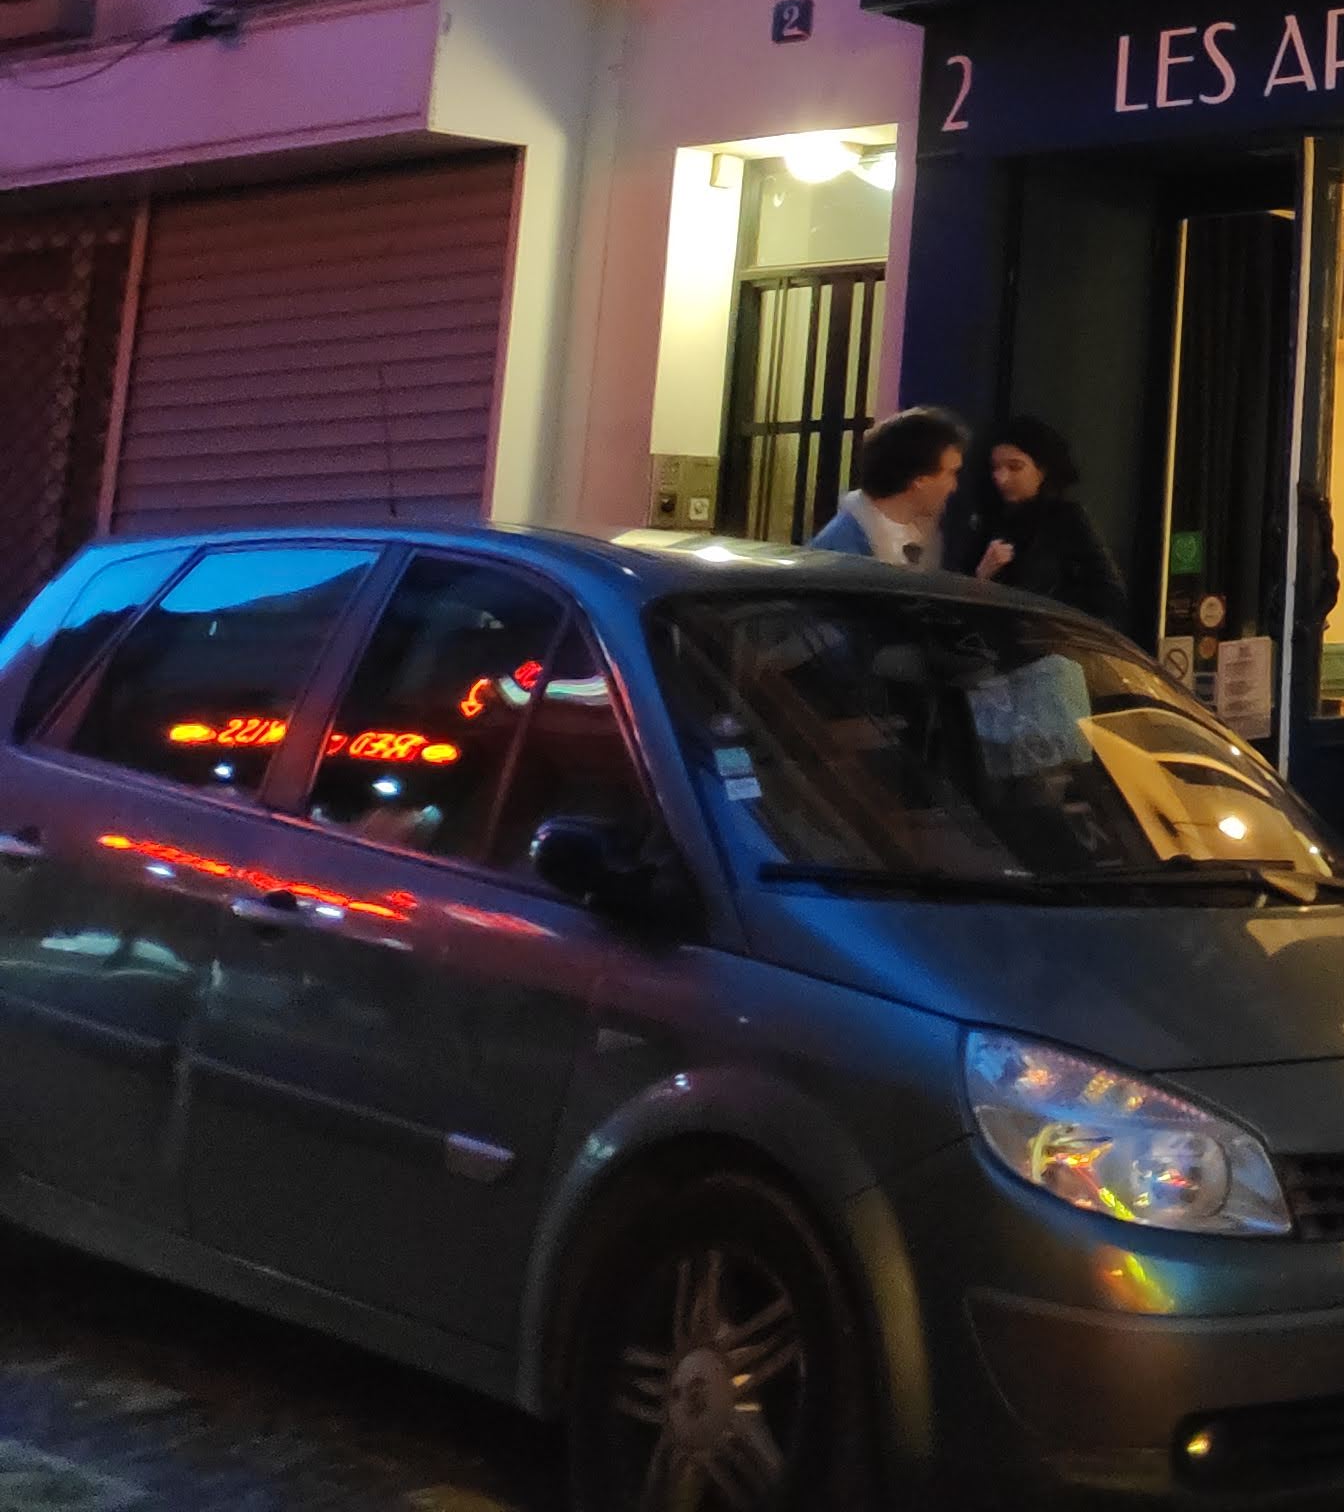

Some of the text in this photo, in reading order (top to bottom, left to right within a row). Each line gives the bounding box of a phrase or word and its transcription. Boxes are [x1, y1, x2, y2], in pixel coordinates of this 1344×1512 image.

[782, 4, 808, 37] 2
[941, 55, 973, 133] 2
[1114, 21, 1237, 114] LES
